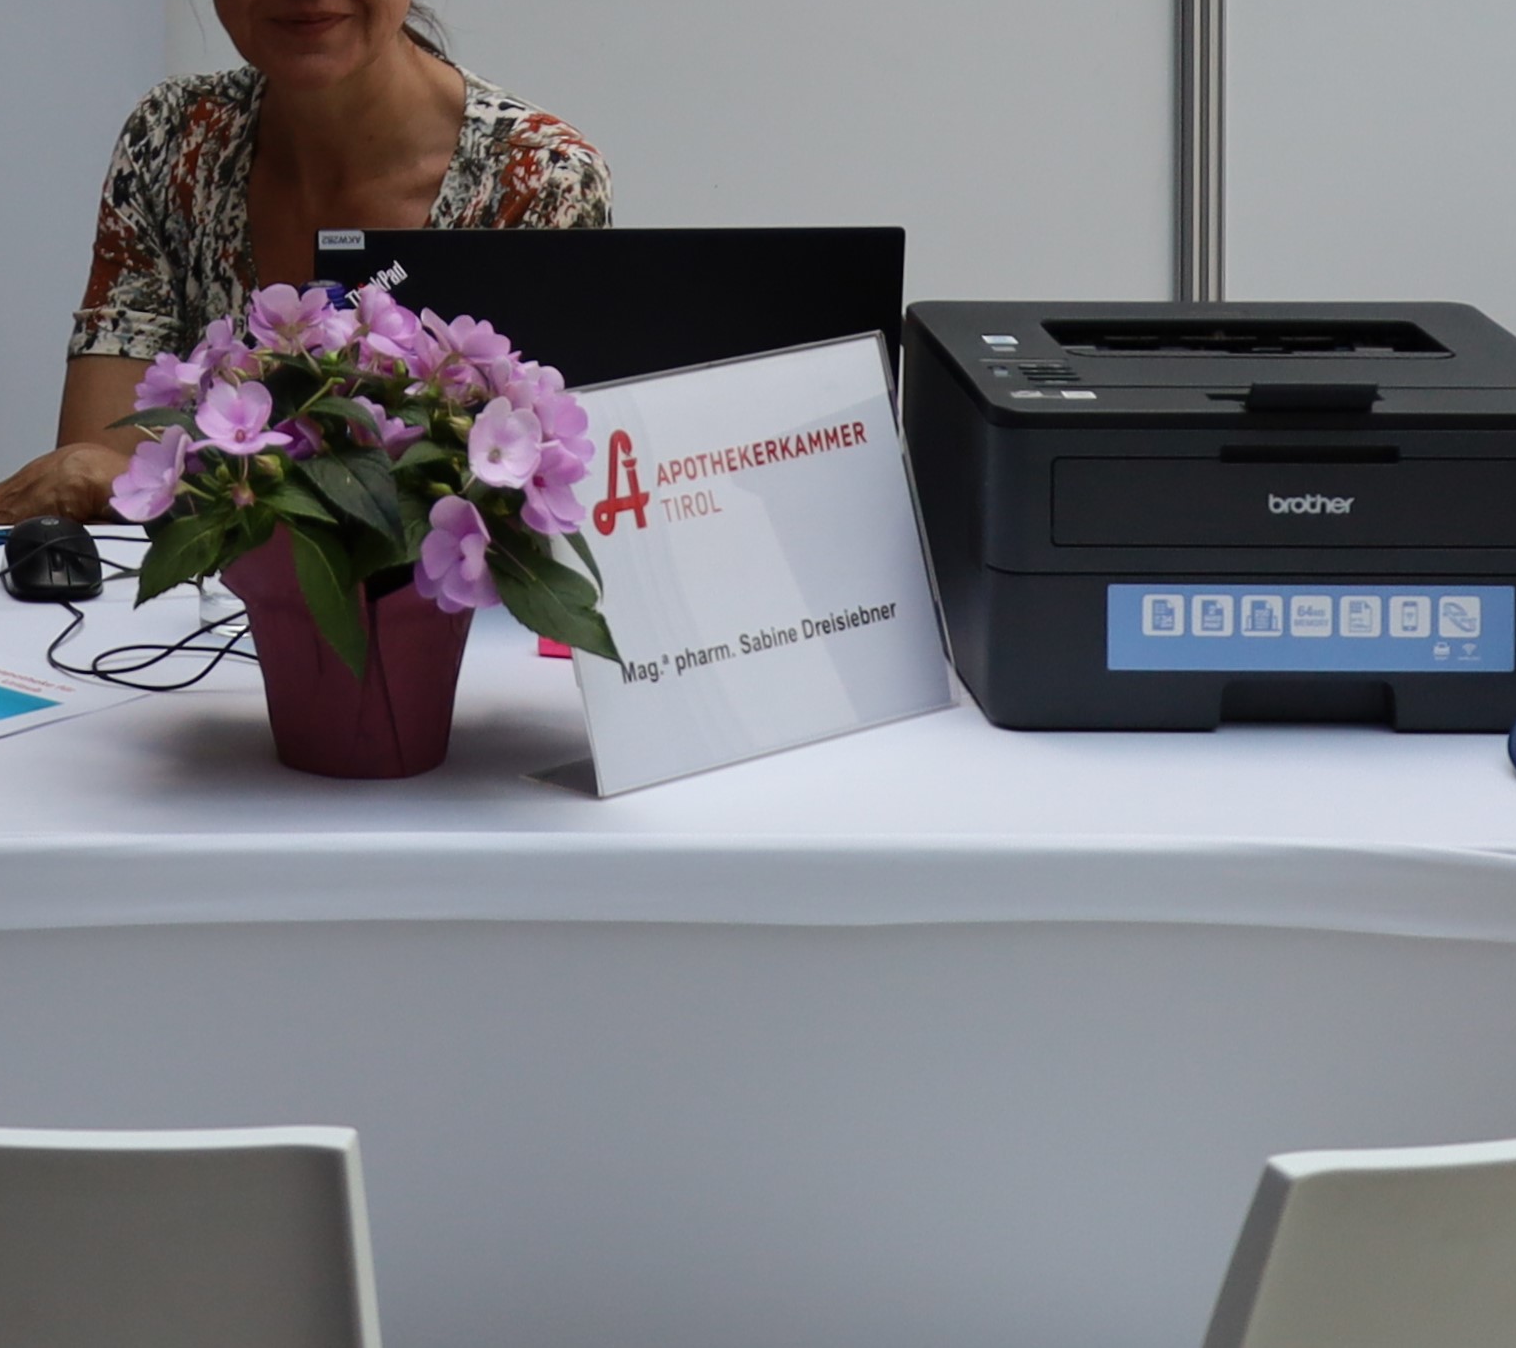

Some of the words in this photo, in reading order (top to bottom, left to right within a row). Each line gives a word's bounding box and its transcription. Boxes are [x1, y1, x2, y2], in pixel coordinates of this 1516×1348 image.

[656, 421, 868, 487] APOTHEKERKAMMER
[662, 490, 722, 524] TIROL
[1269, 494, 1354, 514] brother
[675, 642, 736, 675] pharm.
[740, 625, 798, 655] Sabine
[802, 602, 896, 639] Dreisiebner
